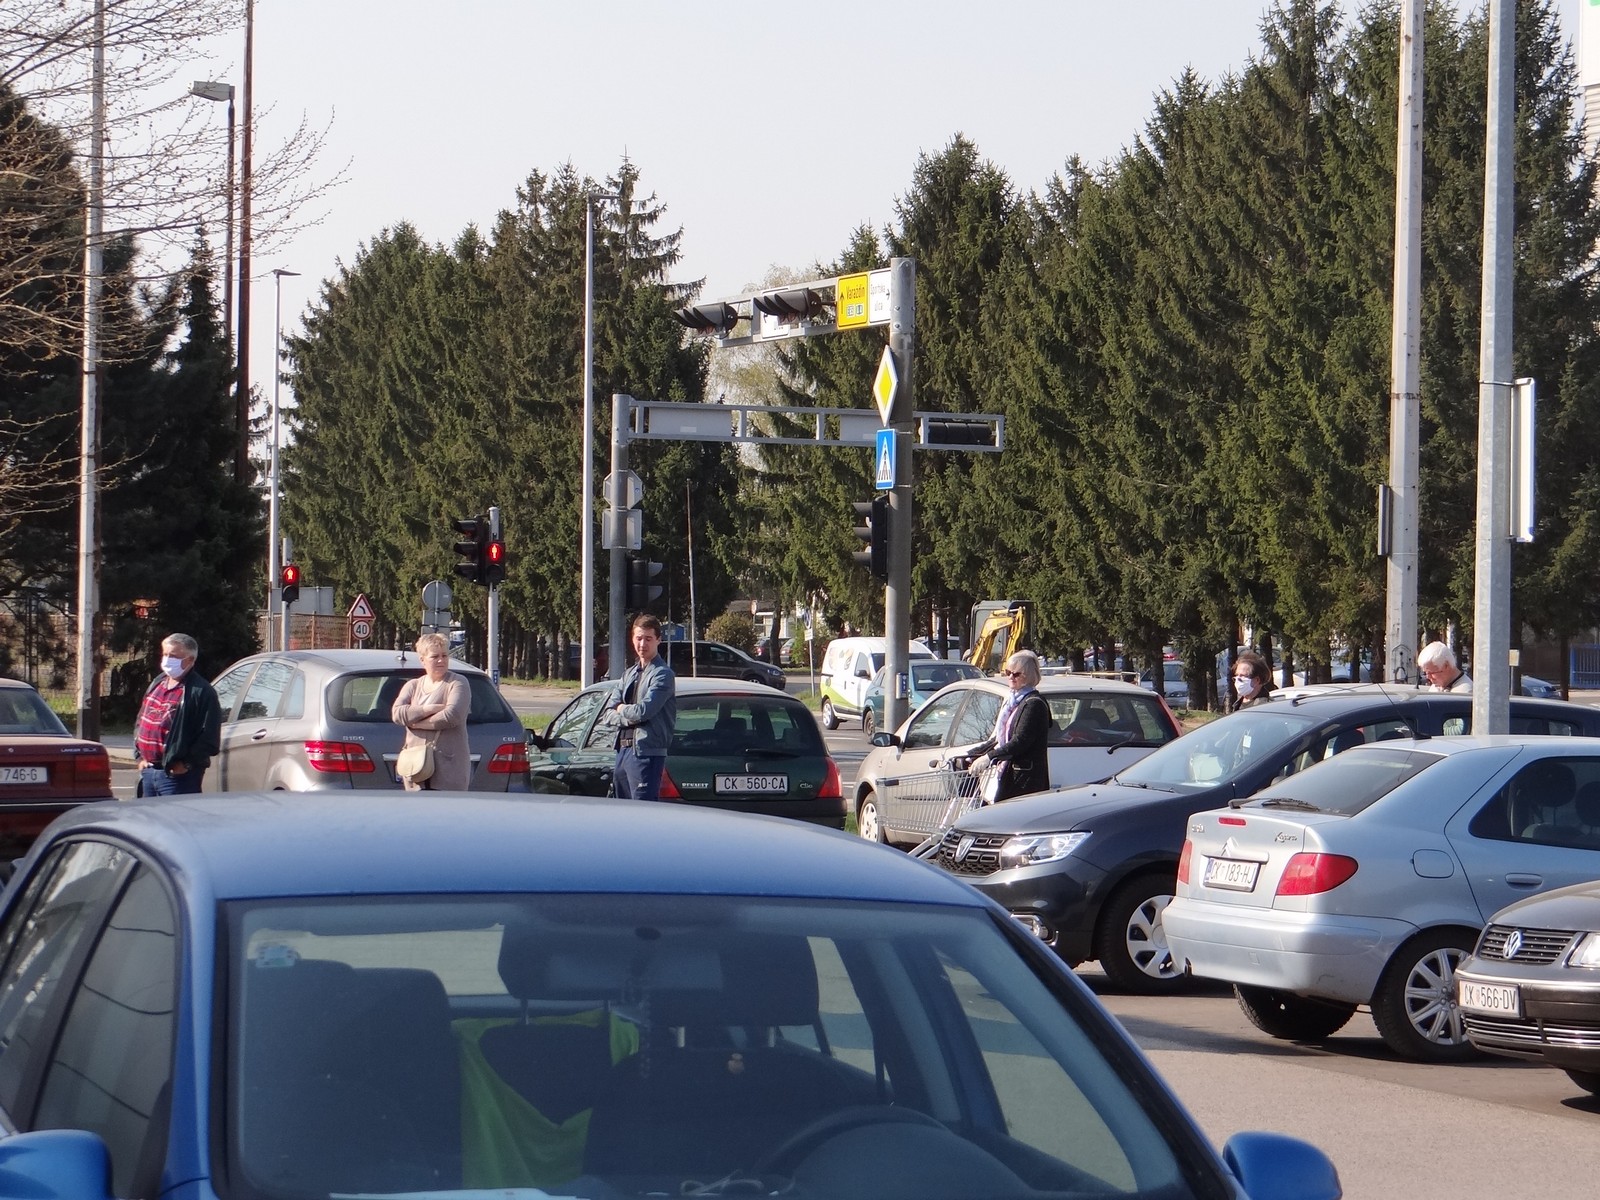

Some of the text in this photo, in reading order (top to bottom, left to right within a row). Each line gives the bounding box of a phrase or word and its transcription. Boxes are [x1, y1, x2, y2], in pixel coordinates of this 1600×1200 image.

[356, 624, 367, 634] 40
[4, 768, 38, 781] 746-G
[724, 777, 785, 790] CK 560-CA
[1210, 861, 1256, 884] CK 183-HJ
[1464, 984, 1517, 1010] CK 566-DV
